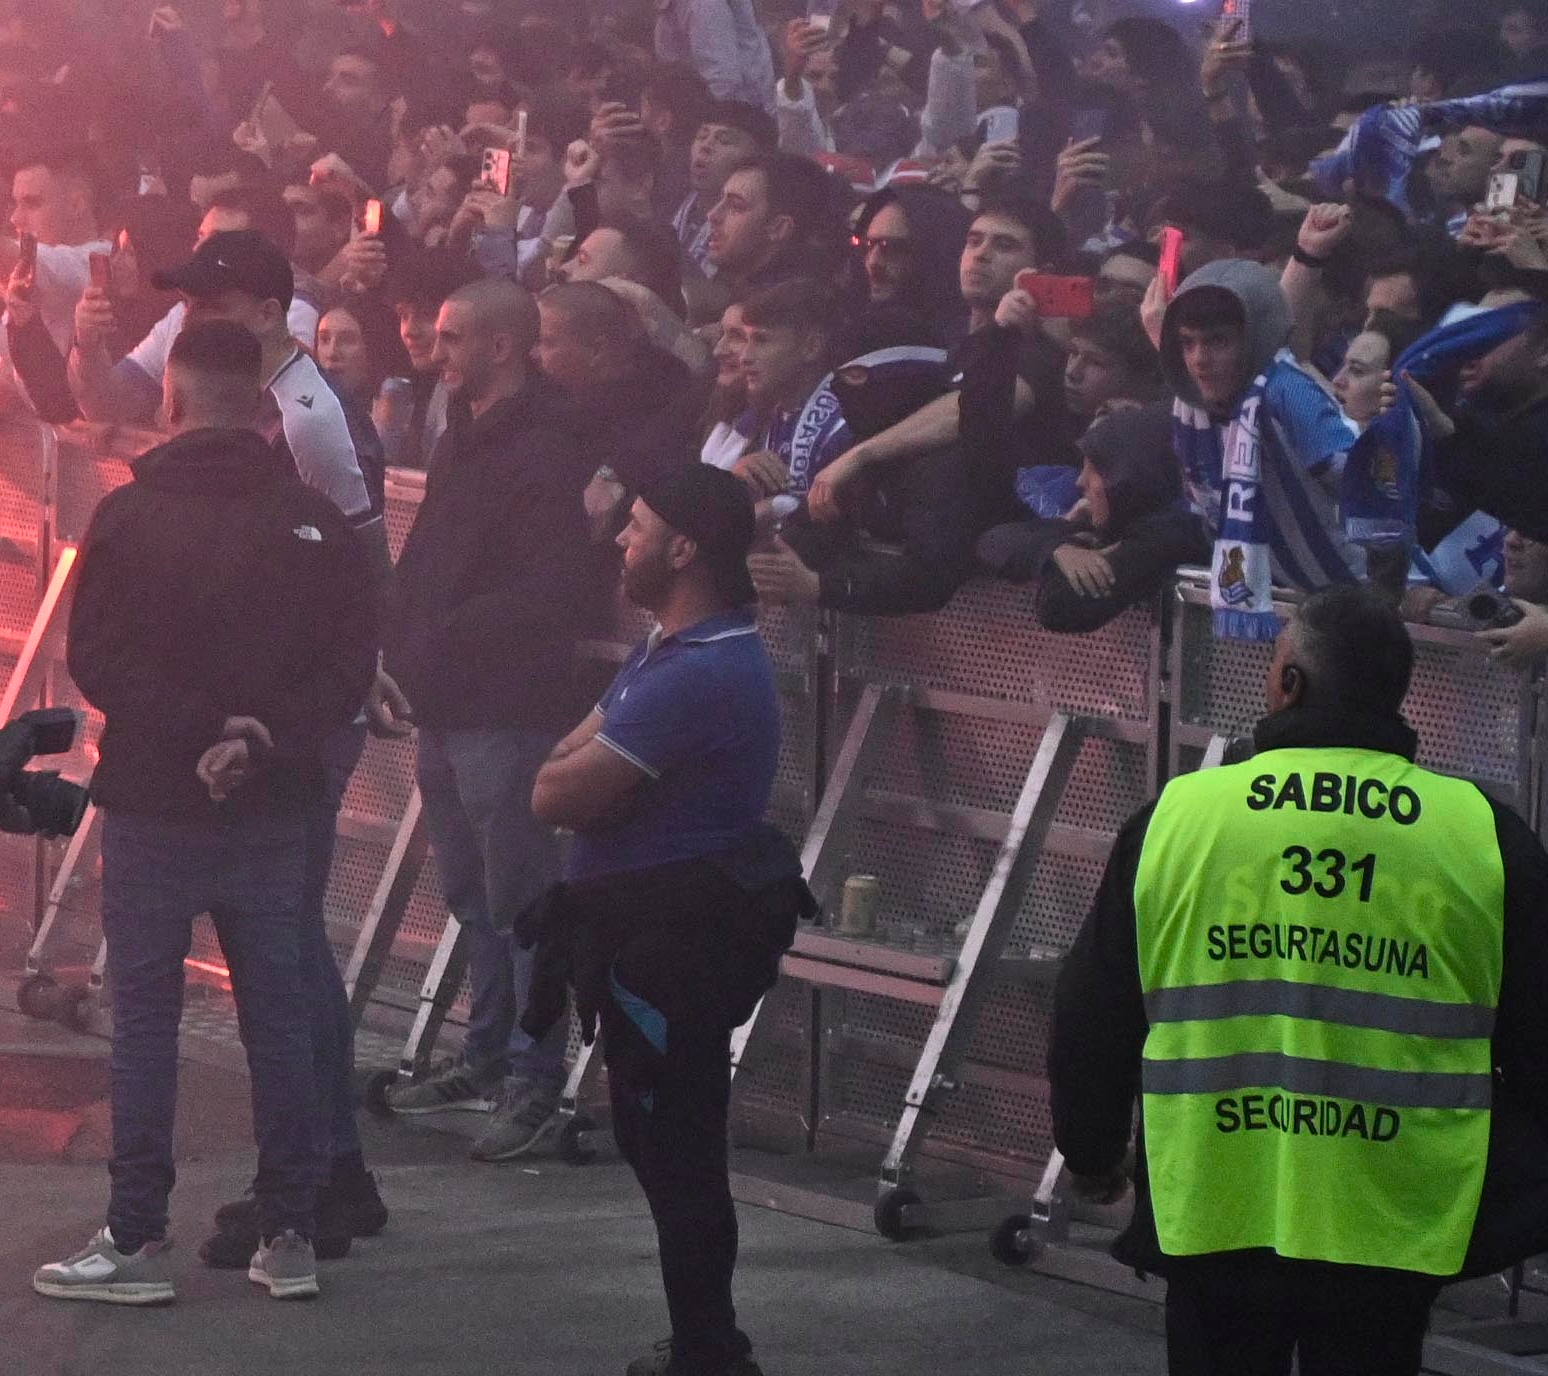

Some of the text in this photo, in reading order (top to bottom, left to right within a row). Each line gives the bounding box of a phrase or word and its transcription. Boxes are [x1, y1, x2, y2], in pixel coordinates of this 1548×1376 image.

[1226, 376, 1264, 522] REA
[1246, 771, 1423, 826] SABICO
[1280, 844, 1377, 903] 331
[1207, 922, 1430, 980] SEGURTASUNA
